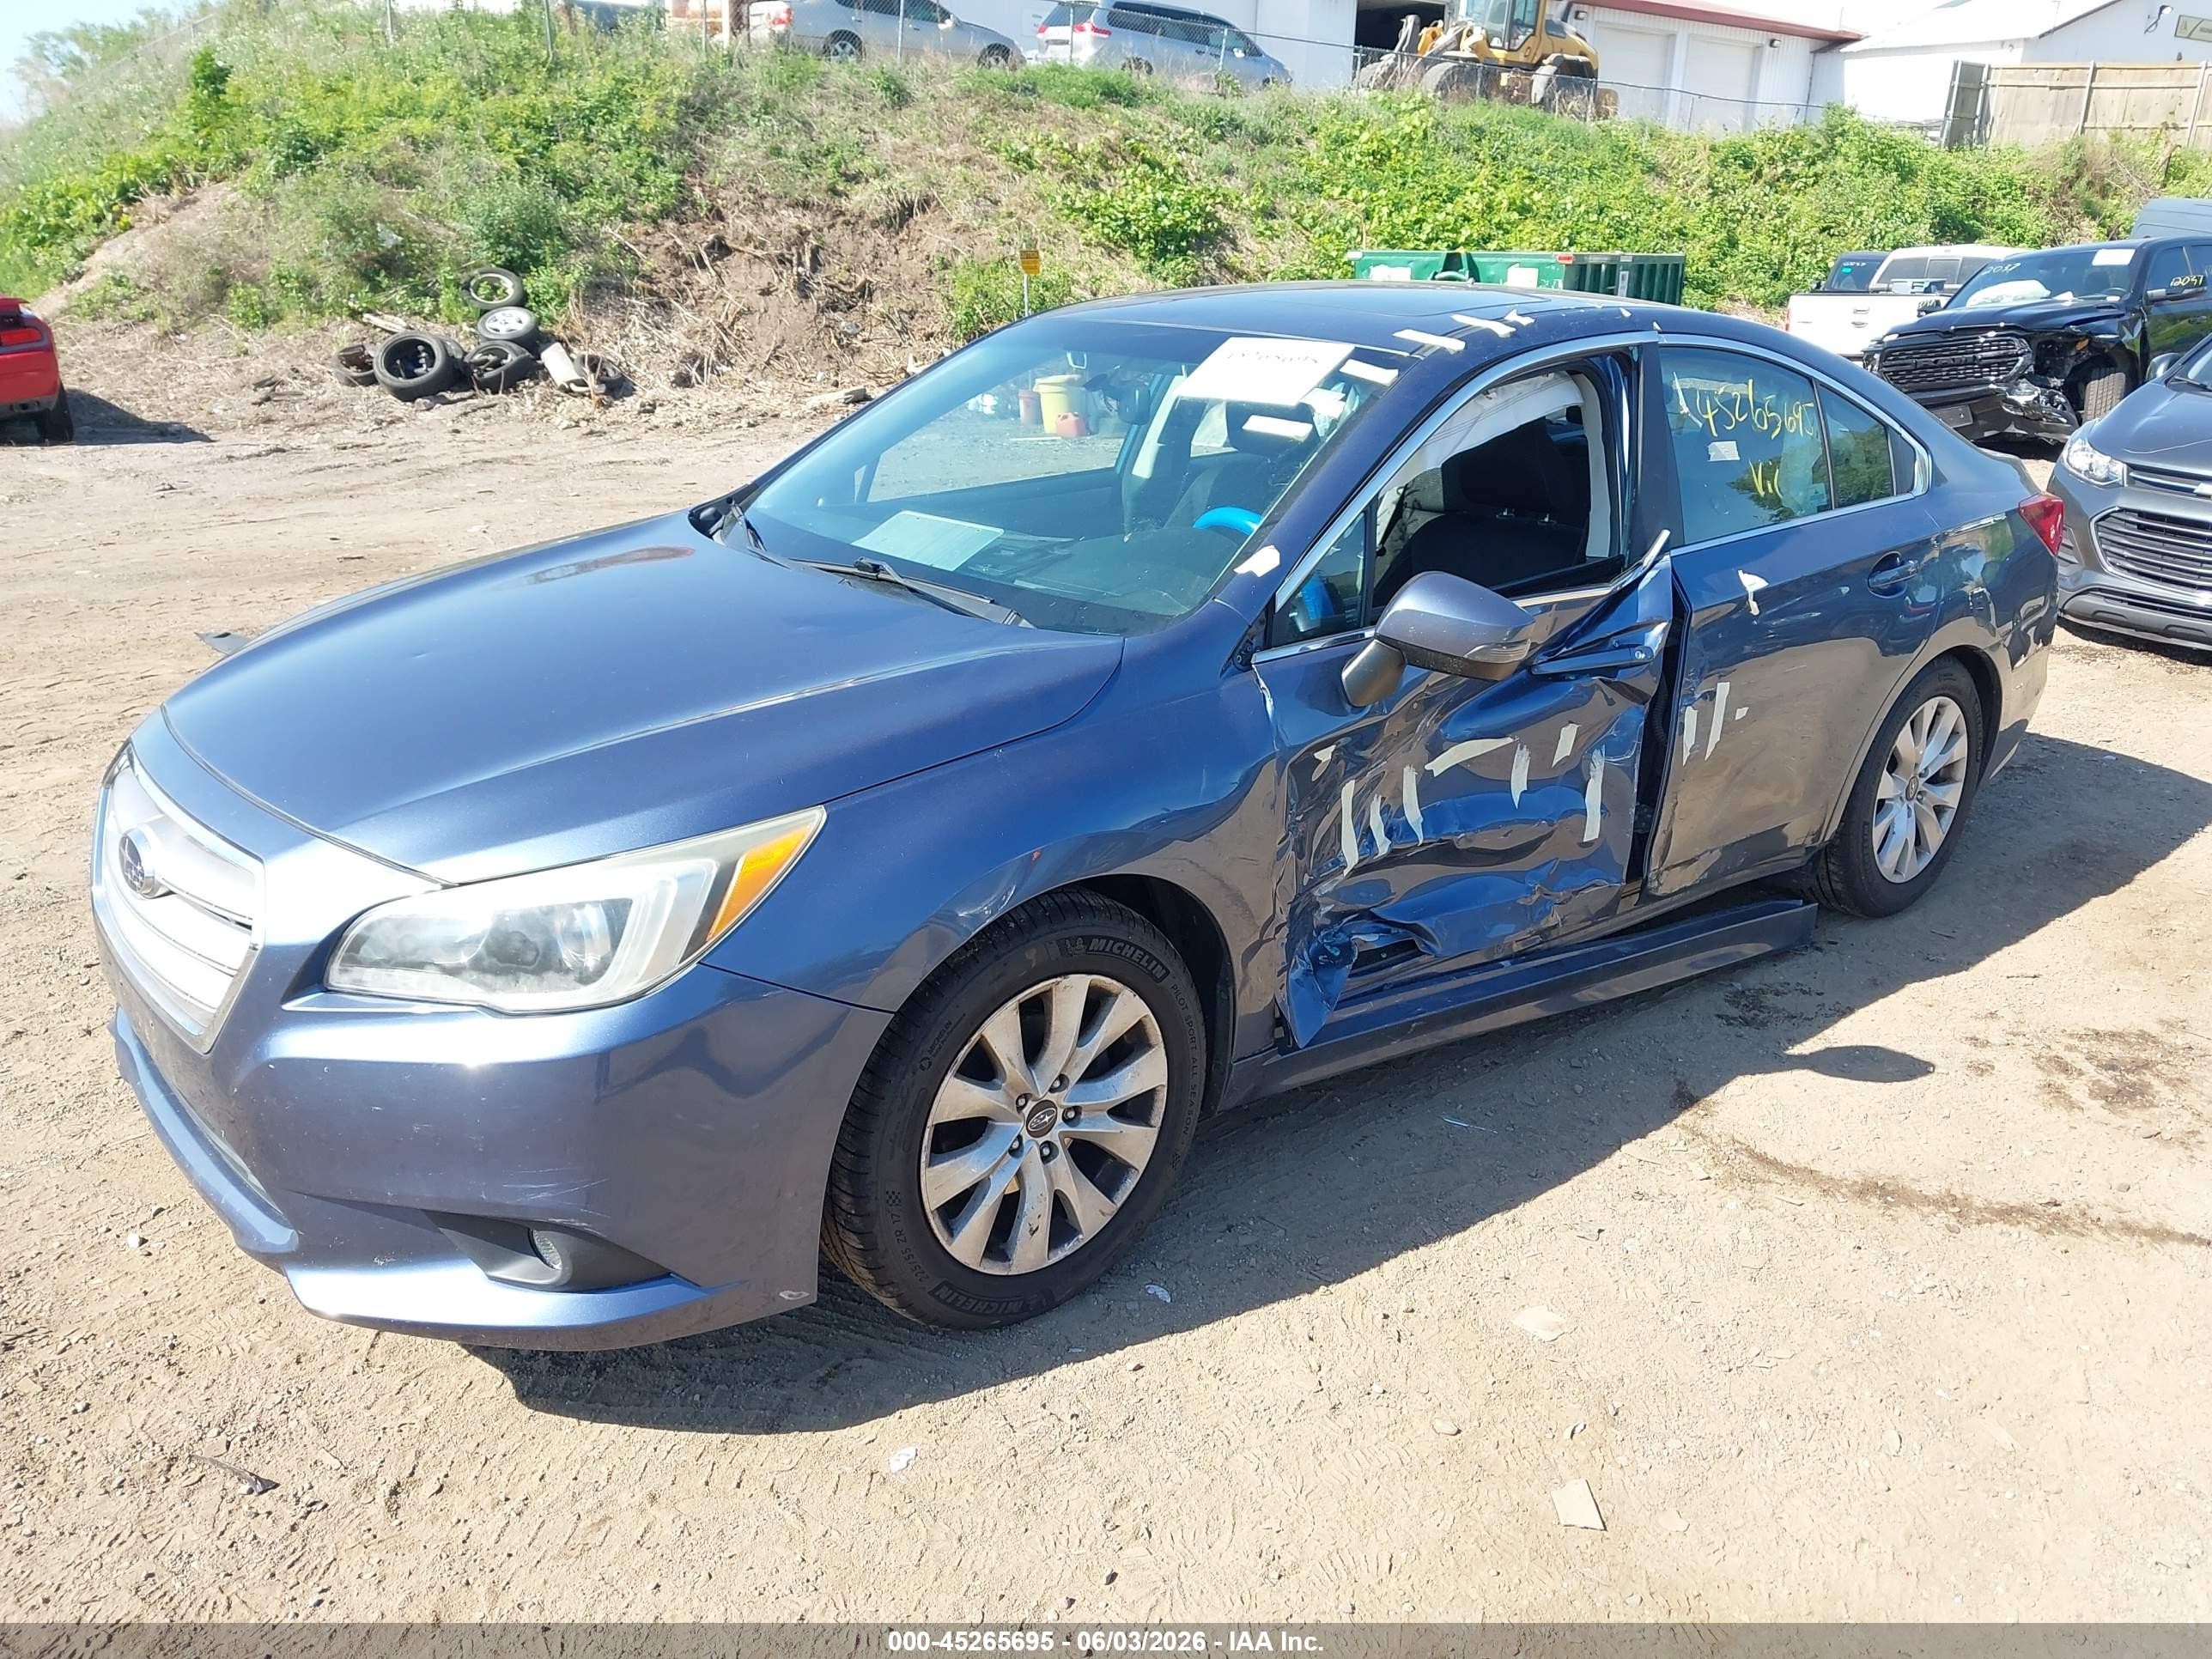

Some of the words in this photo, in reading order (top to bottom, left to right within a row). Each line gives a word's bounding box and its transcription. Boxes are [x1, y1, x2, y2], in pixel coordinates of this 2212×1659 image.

[1089, 938, 1166, 980] MICHELIN
[1170, 983, 1188, 1011] PILOT
[1185, 1015, 1197, 1050] SPORT
[890, 1212, 901, 1224] 17
[895, 1229, 908, 1244] ZR
[901, 1248, 930, 1283] 225/55
[933, 1285, 1024, 1315] MICHELIN
